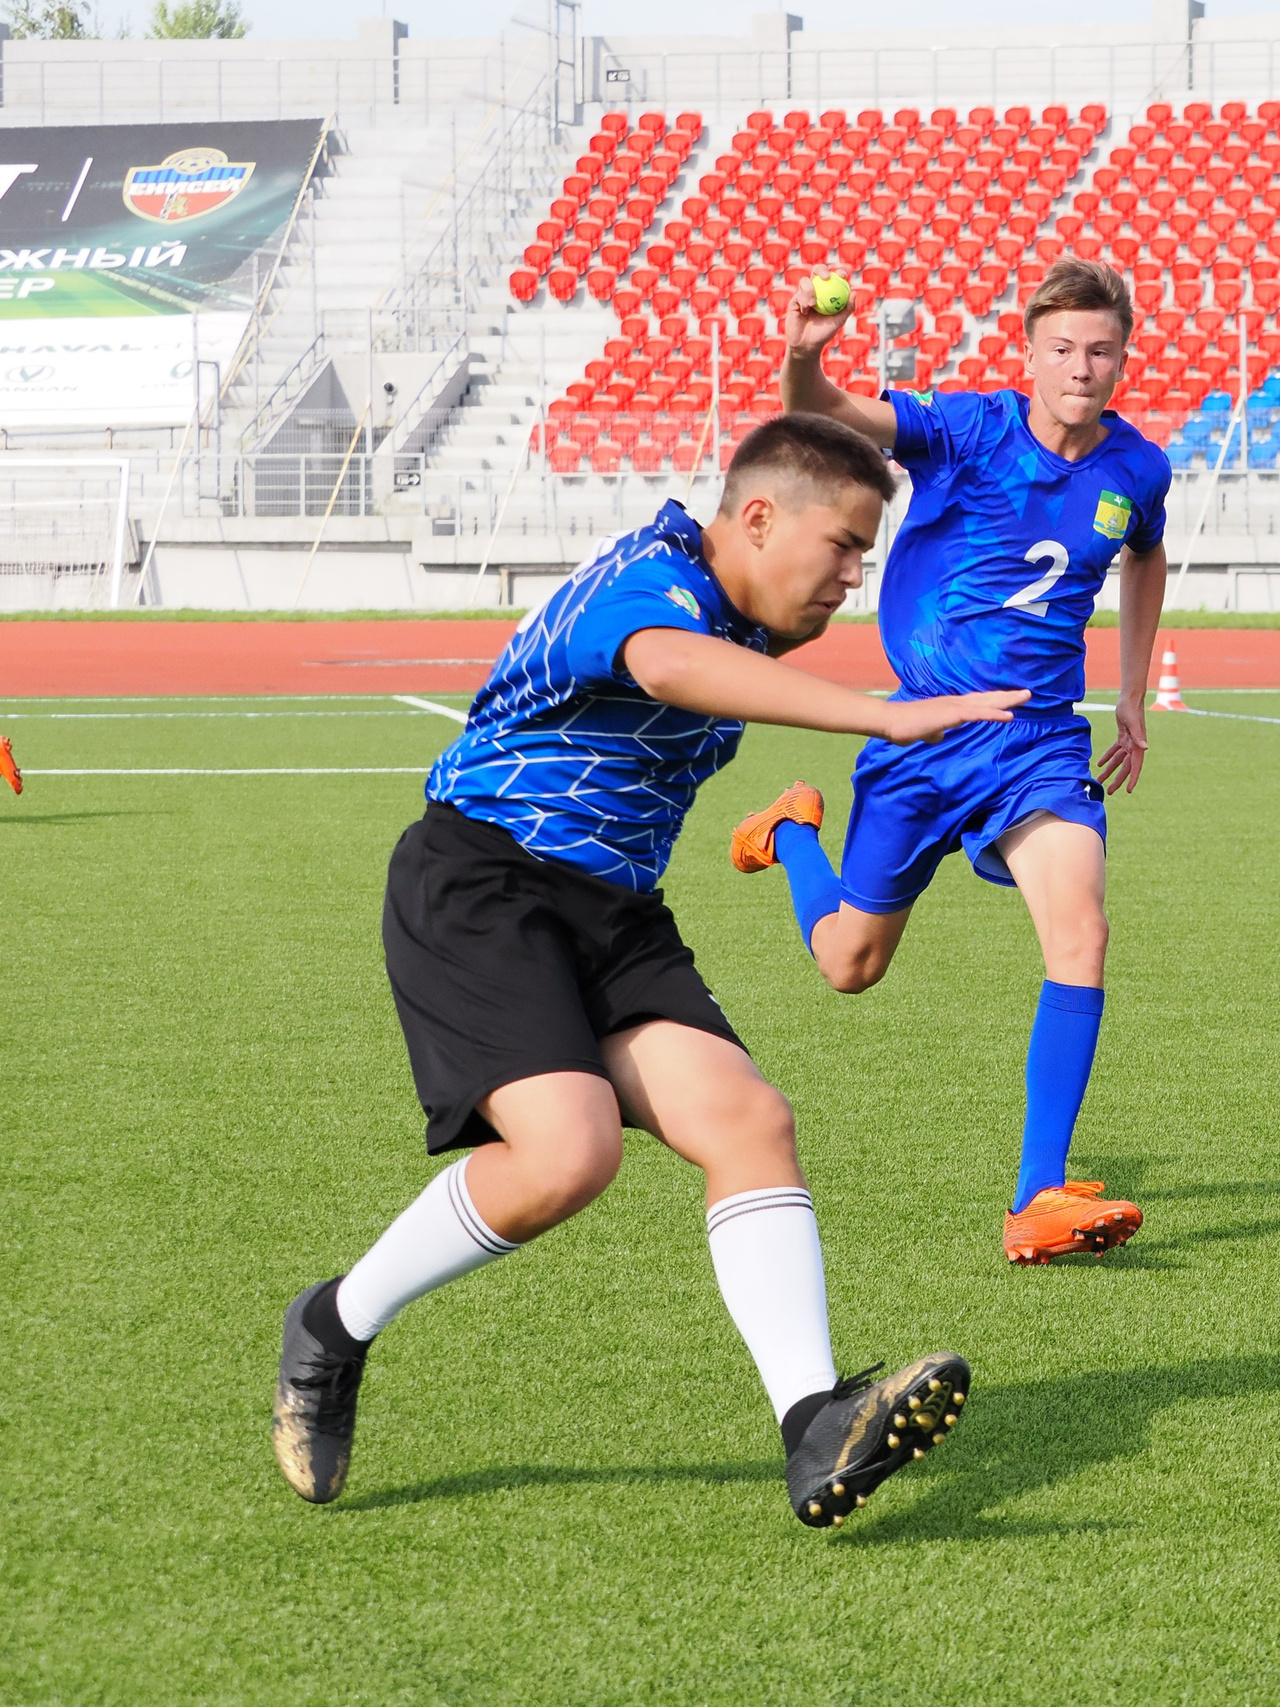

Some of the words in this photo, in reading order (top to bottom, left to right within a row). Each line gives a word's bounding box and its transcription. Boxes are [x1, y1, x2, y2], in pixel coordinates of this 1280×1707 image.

[127, 176, 243, 196] ЕНИСЕЙ
[0, 240, 187, 270] ЖНЫЙ
[1002, 539, 1069, 618] 2
